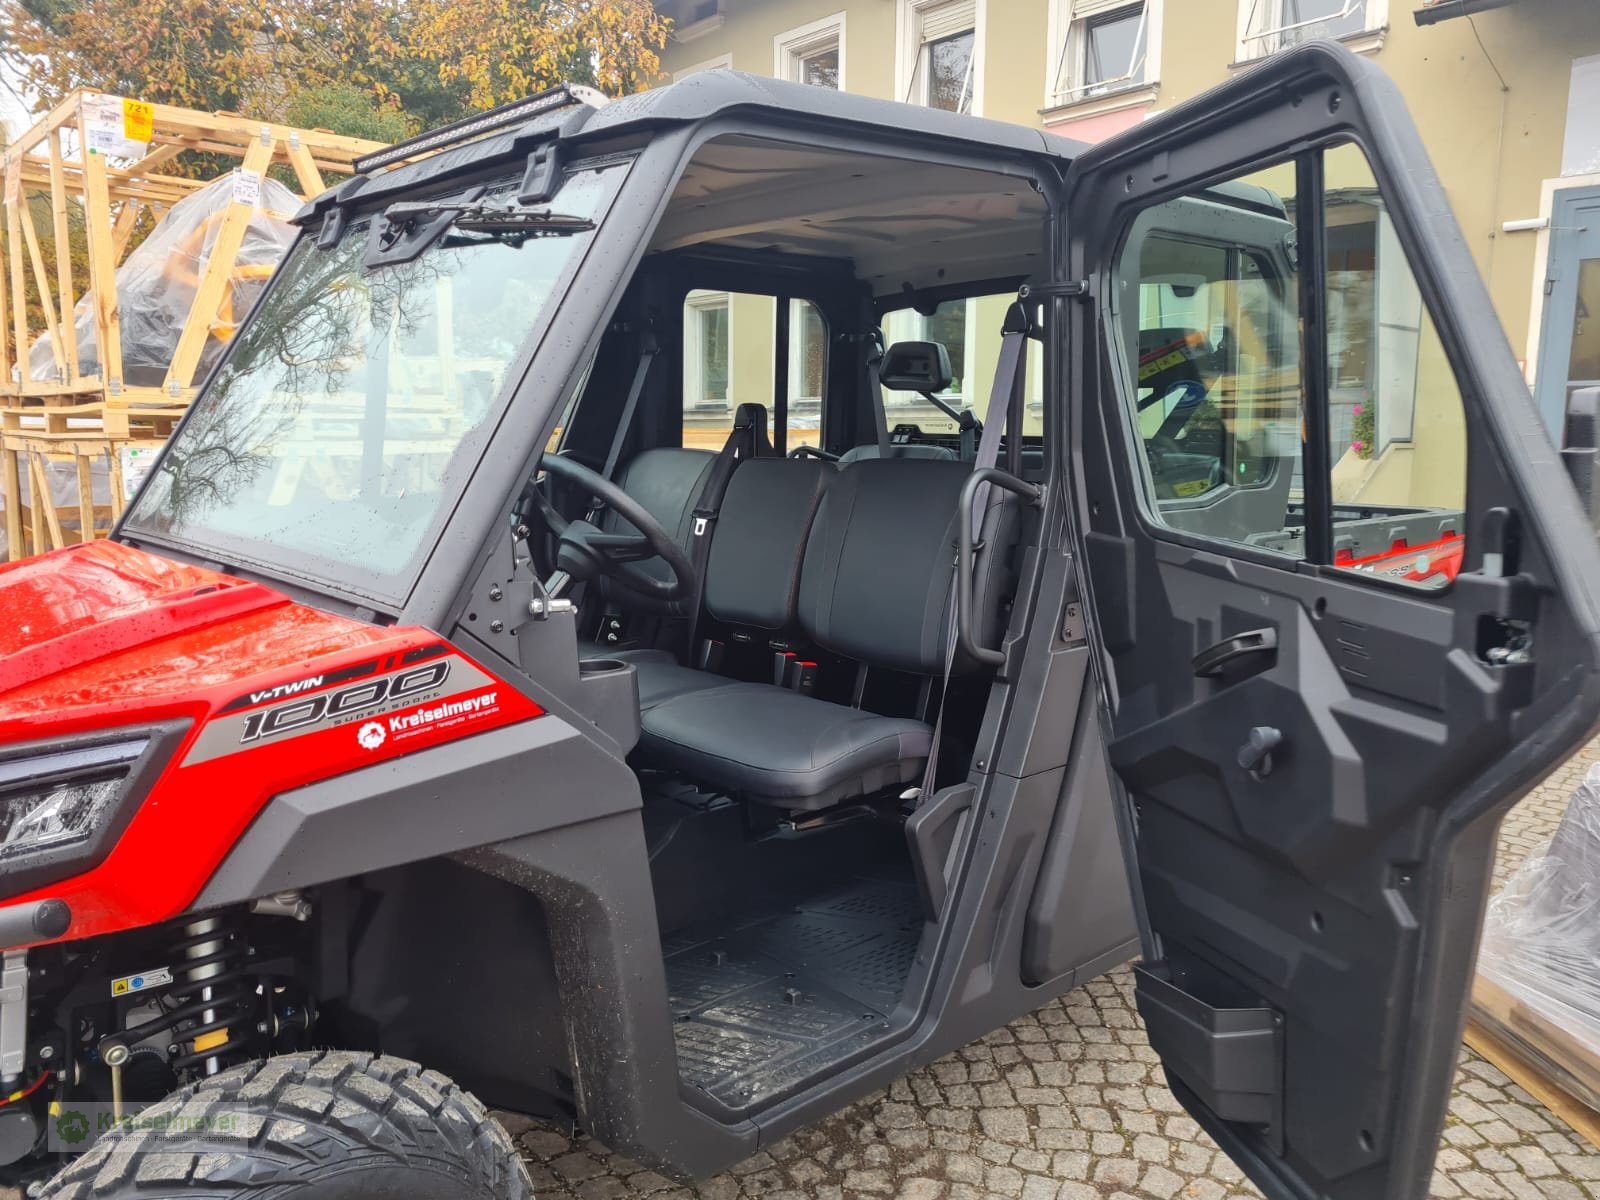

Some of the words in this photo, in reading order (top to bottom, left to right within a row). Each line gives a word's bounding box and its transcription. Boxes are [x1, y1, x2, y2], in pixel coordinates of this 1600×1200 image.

[127, 102, 149, 114] 721
[240, 660, 451, 744] 1000
[250, 675, 324, 704] V-TWIN
[334, 707, 386, 725] SUPER
[389, 692, 497, 732] Kreiselmeyer
